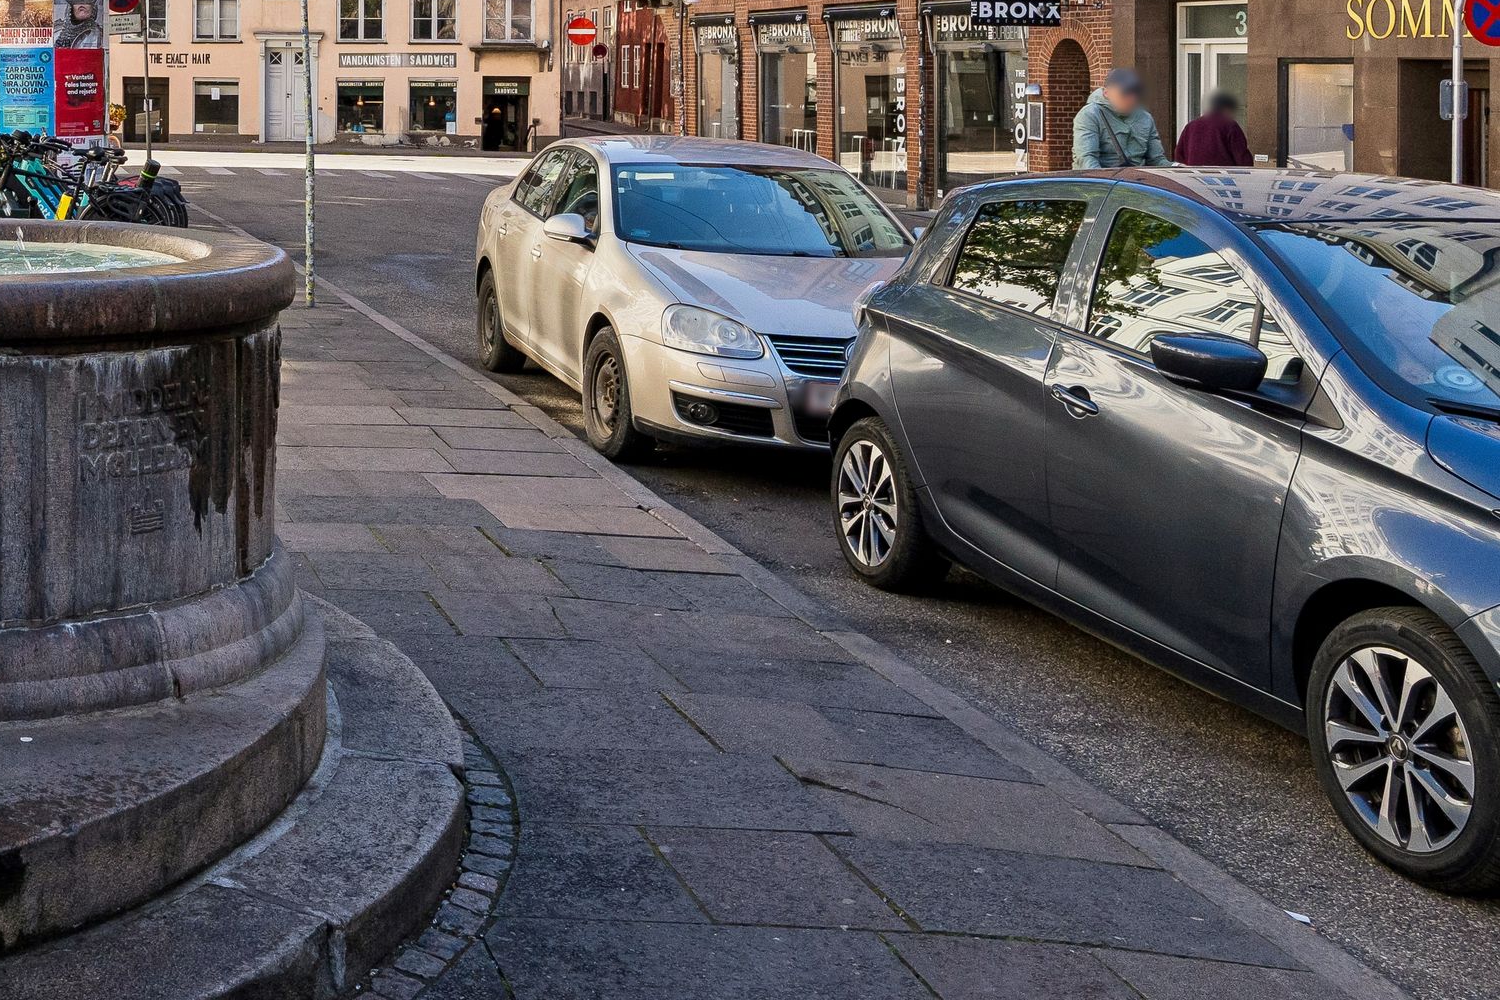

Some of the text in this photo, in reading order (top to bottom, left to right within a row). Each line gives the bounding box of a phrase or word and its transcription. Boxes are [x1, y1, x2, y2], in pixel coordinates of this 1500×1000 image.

[980, 1, 1060, 19] BRONX
[772, 23, 802, 37] BRONX
[1235, 10, 1247, 36] 3
[22, 28, 52, 37] STADION
[708, 25, 734, 39] BRONX
[149, 53, 210, 64] THE EXACT HAIR
[341, 55, 455, 65] VANDKUNSTEN SANDWICH
[896, 78, 906, 172] BRONX
[1015, 83, 1026, 171] BRON
